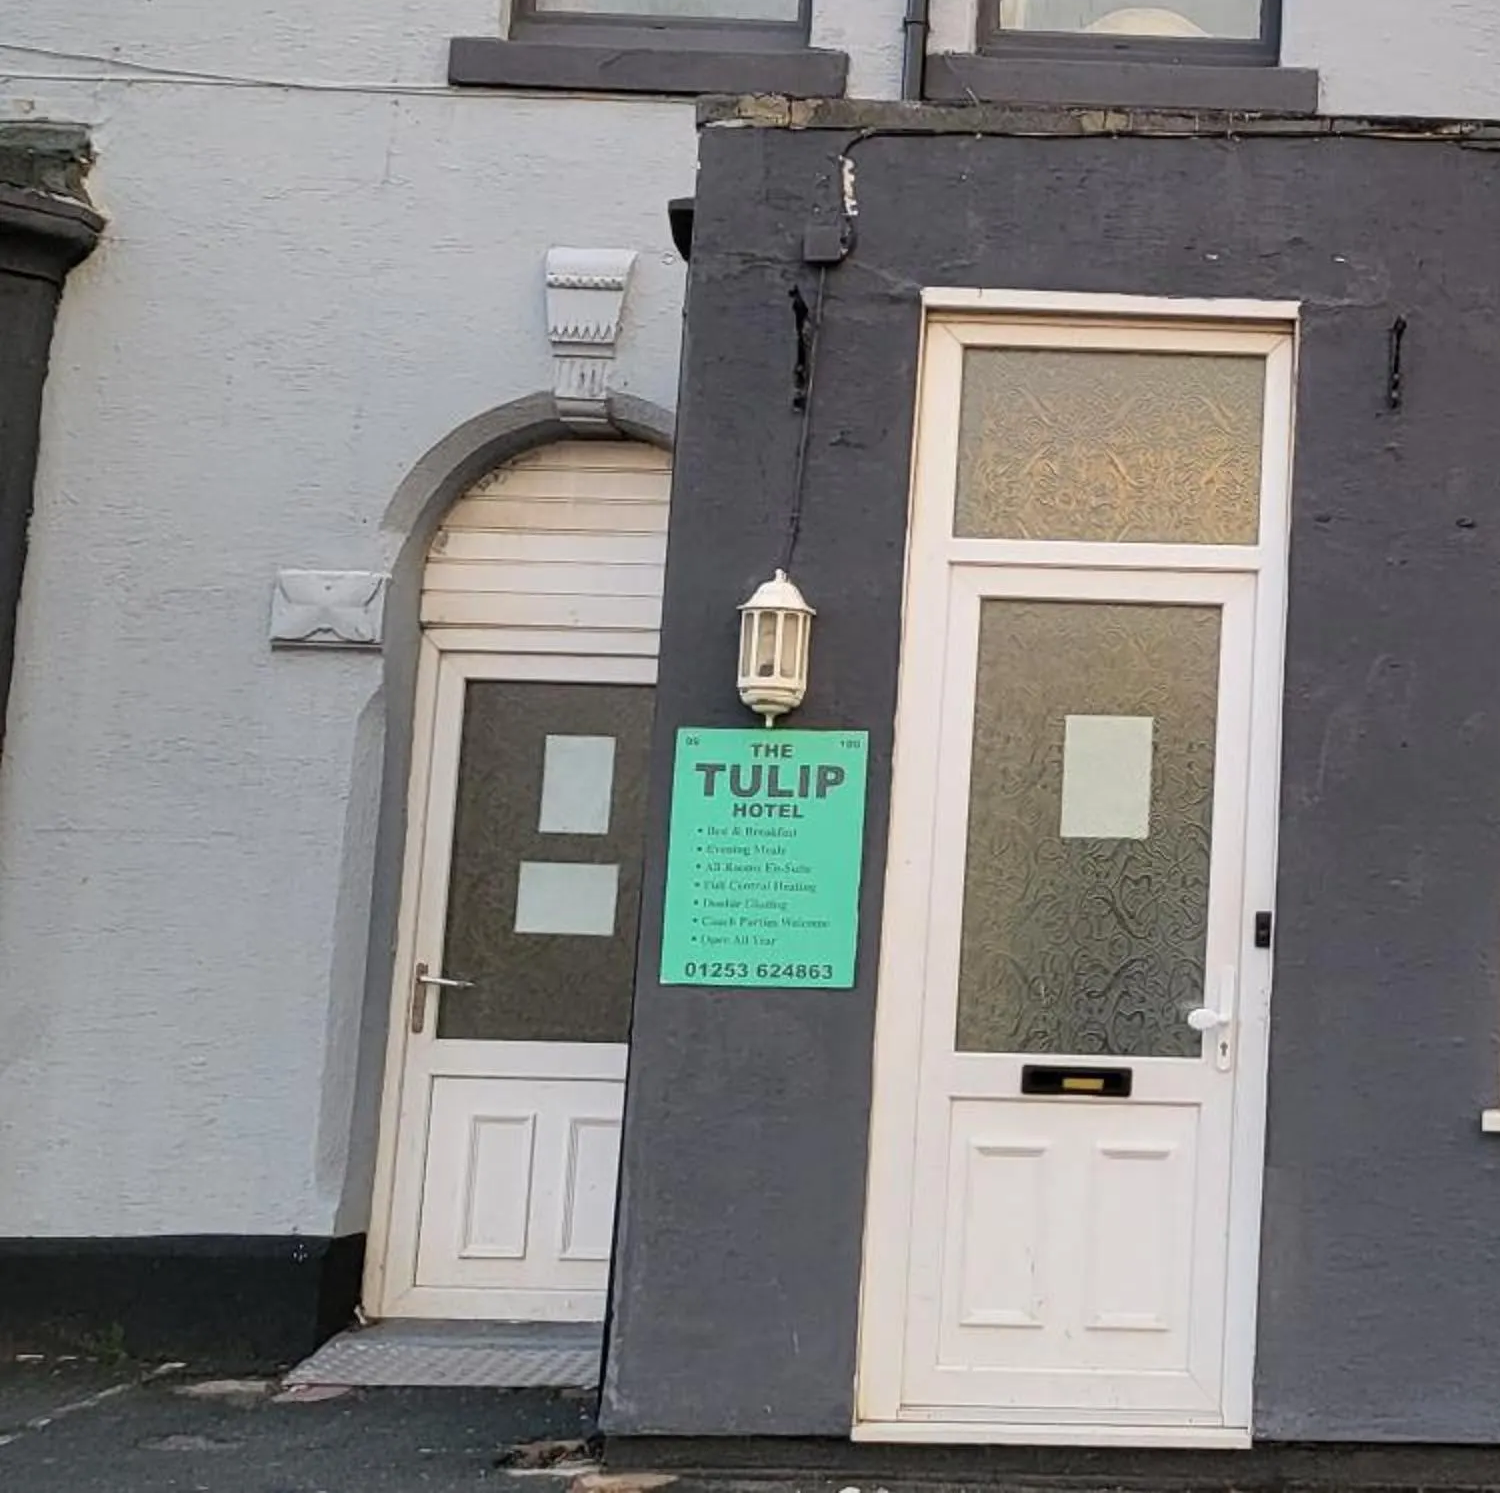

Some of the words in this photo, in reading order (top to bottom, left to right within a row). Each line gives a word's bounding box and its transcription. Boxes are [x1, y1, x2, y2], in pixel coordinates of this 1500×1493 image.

[750, 743, 794, 759] THE
[695, 763, 846, 800] TULIP
[731, 803, 804, 819] HOTEL
[745, 827, 798, 838] Breakfast
[706, 843, 751, 856] Evening
[773, 882, 817, 893] Heating
[733, 935, 749, 945] All
[752, 935, 777, 946] Year
[684, 962, 749, 978] 01253
[755, 964, 834, 980] 624863
